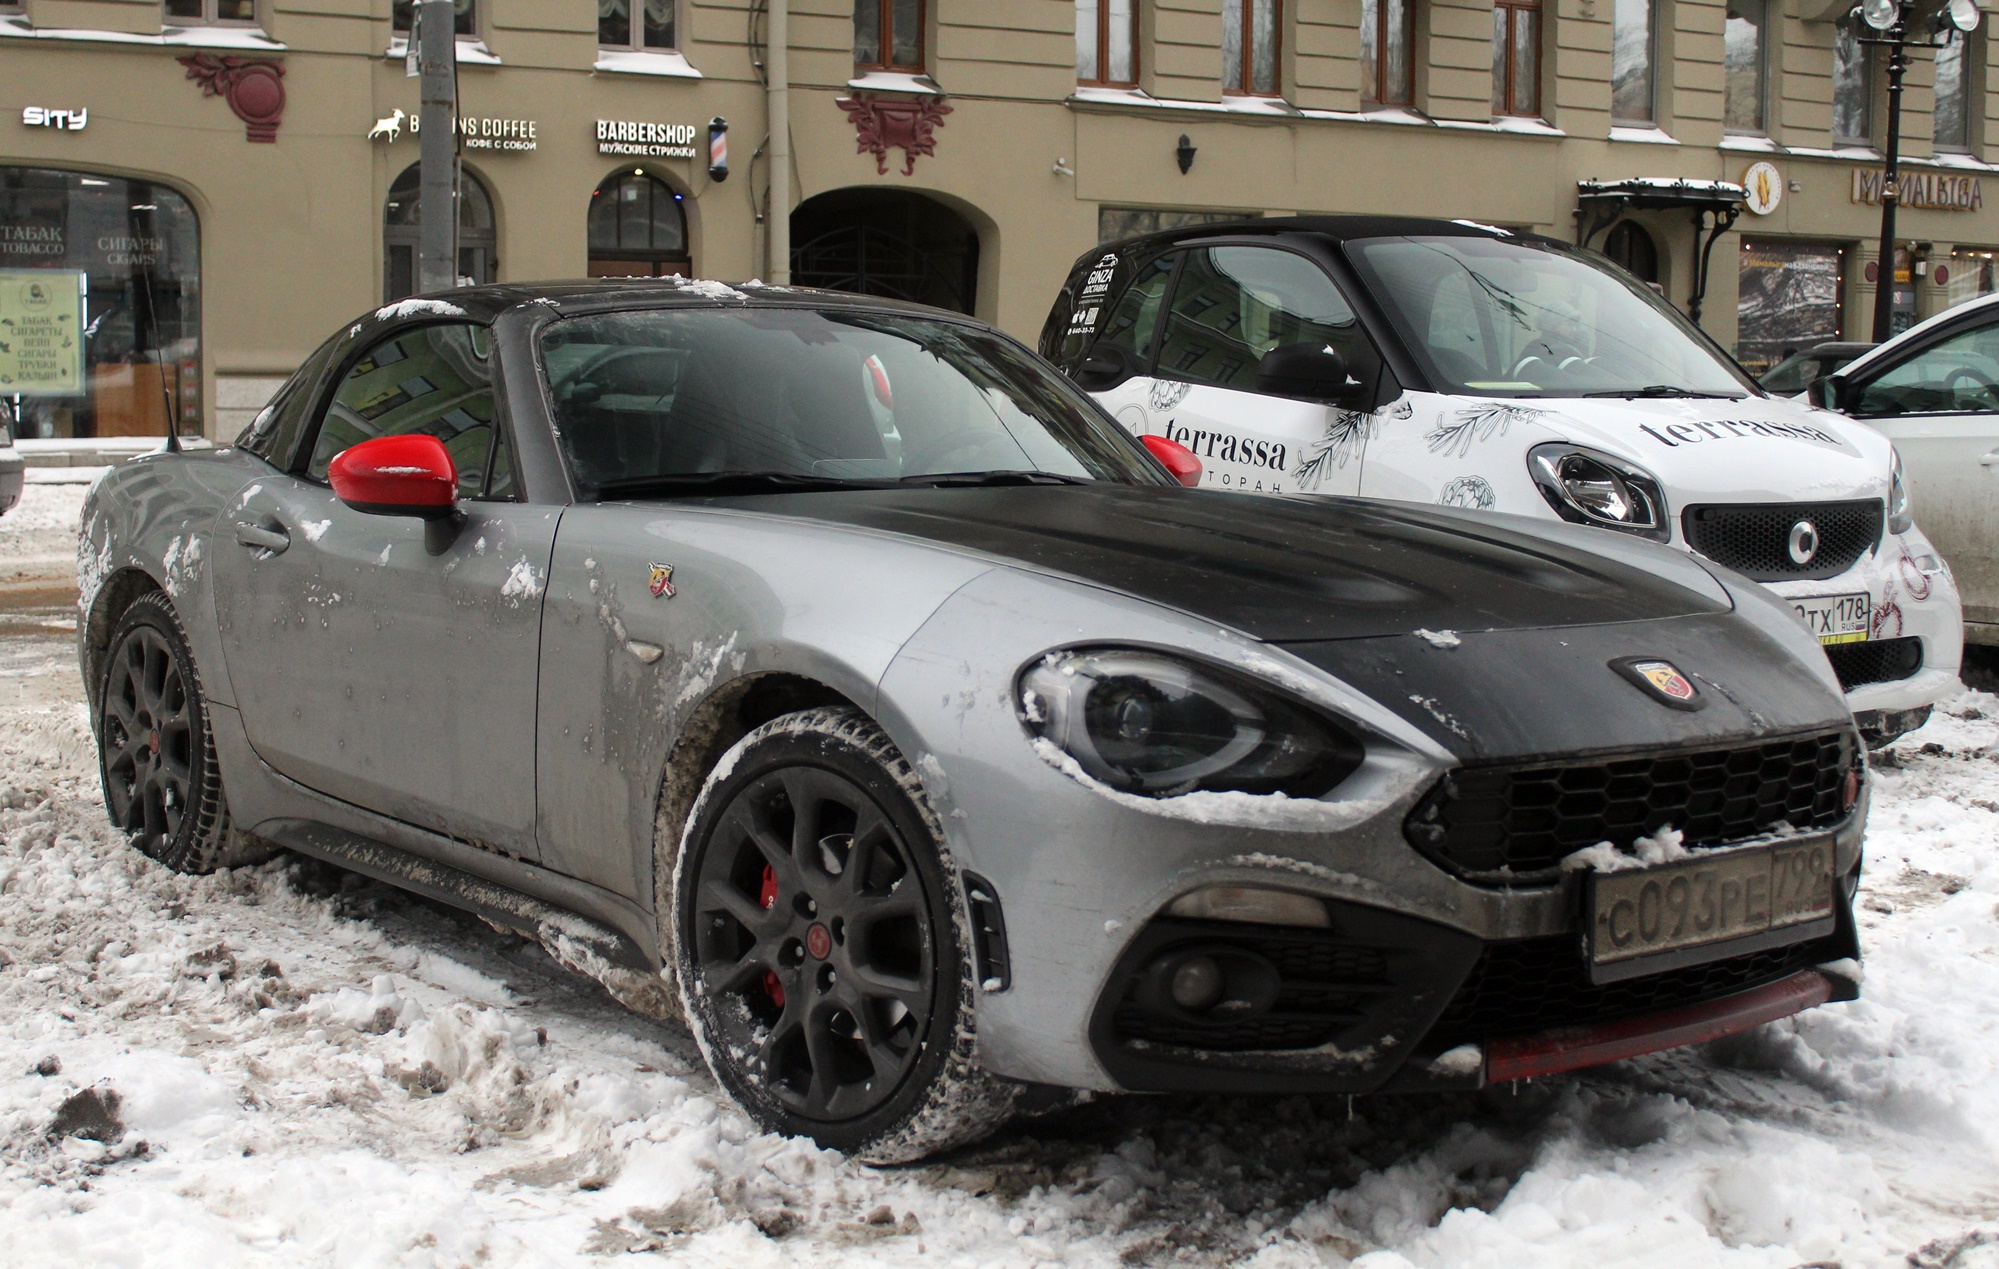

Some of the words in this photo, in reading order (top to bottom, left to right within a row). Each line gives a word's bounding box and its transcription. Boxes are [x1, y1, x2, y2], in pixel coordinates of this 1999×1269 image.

[482, 118, 537, 138] COFFEE
[597, 119, 696, 145] BARBERSHOP
[466, 138, 492, 149] КОФЕ
[494, 139, 501, 149] С
[503, 139, 537, 151] СОБОЙ
[599, 142, 648, 155] МУЖСКИЕ
[649, 144, 696, 158] СТРИЖКИ
[1, 225, 63, 242] ТАБАК
[1, 241, 65, 255] TOBACCO
[97, 236, 164, 251] СИГАРЫ
[106, 253, 156, 265] CIGARS
[1087, 268, 1115, 285] GINZA
[1082, 283, 1109, 295] ДОСТАВКА
[22, 316, 52, 326] ТАБАК
[10, 326, 63, 337] СИГАРЕТЫ
[17, 349, 57, 359] СИГАРЫ
[18, 360, 57, 370] ТРУБКИ
[1638, 419, 1842, 448] terrassa
[1165, 418, 1287, 472] terrassa
[1836, 597, 1864, 622] 178
[1841, 621, 1855, 632] RUS
